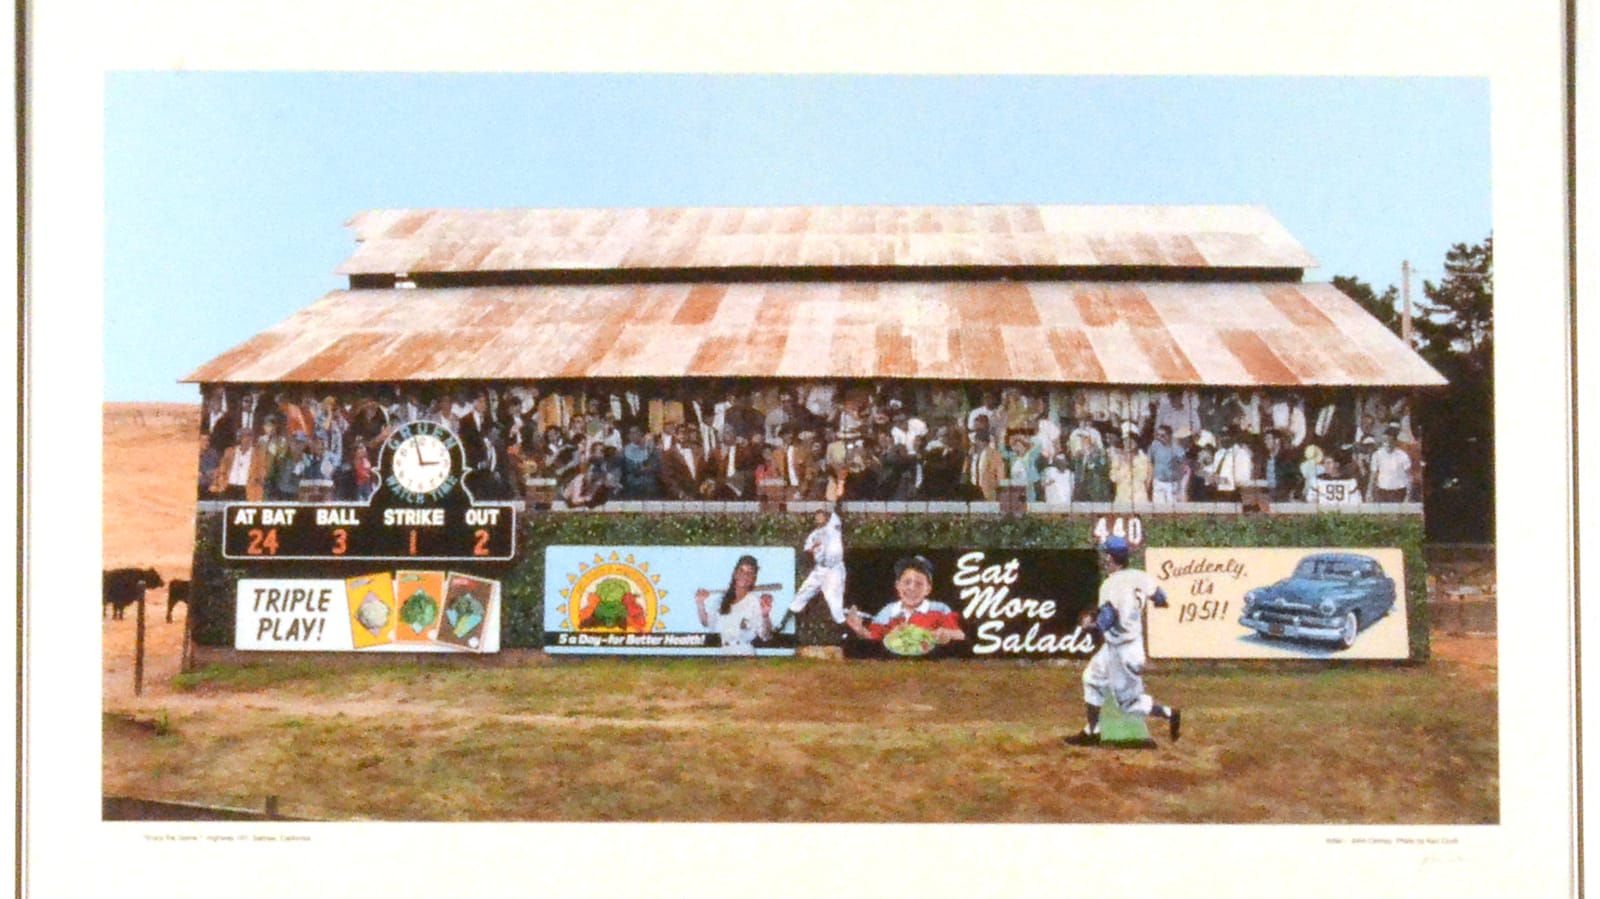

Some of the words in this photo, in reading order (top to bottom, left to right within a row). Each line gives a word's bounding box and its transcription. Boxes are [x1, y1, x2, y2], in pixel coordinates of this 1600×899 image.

[1325, 483, 1345, 501] 99
[234, 509, 256, 525] AT
[261, 509, 296, 525] BAT
[316, 509, 360, 525] BALL
[384, 508, 445, 525] STRIKE
[465, 508, 500, 525] OUT
[248, 529, 280, 555] 24
[332, 529, 347, 555] 3
[409, 529, 417, 555] 1
[473, 529, 489, 555] 2
[1094, 517, 1142, 544] 440
[953, 552, 1021, 586] Eat
[1190, 578, 1214, 597] it's
[252, 588, 332, 613] TRIPLE
[959, 586, 1056, 620] More
[1178, 600, 1229, 624] 1951!
[256, 617, 326, 642] PLAY!
[625, 633, 663, 646] Better
[663, 634, 706, 646] Health!
[973, 621, 1095, 655] Salads
